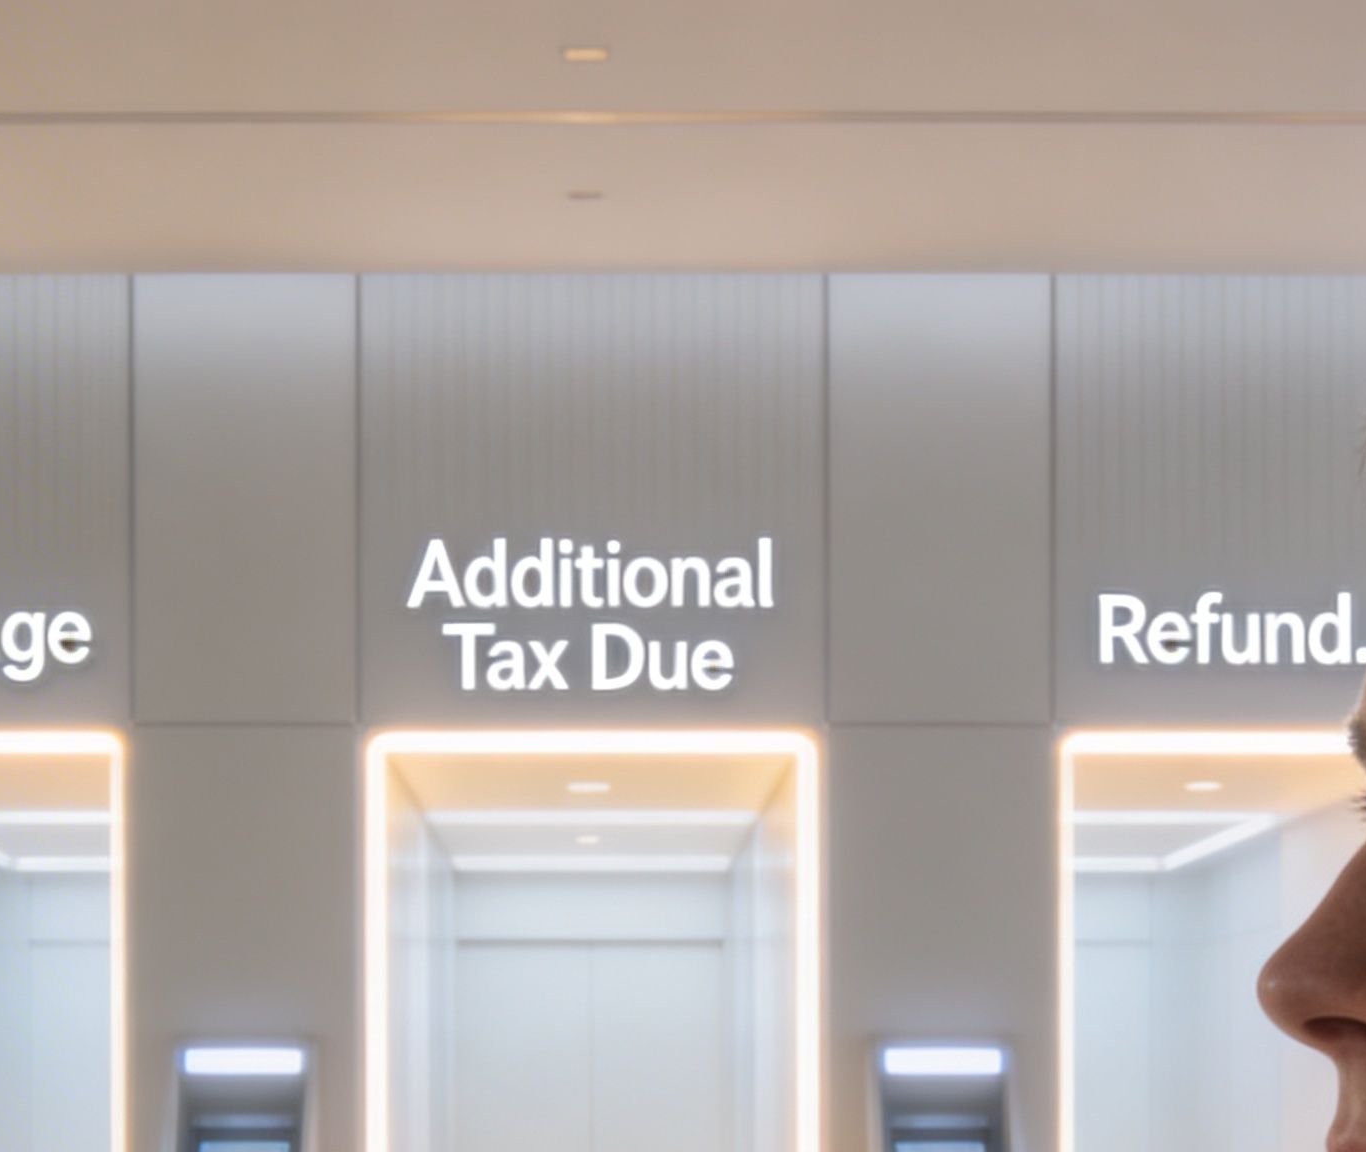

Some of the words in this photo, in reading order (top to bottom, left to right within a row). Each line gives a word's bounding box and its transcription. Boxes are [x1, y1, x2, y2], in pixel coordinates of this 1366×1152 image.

[406, 537, 774, 608] Additional
[442, 623, 569, 690] Tax
[592, 623, 734, 690] Due
